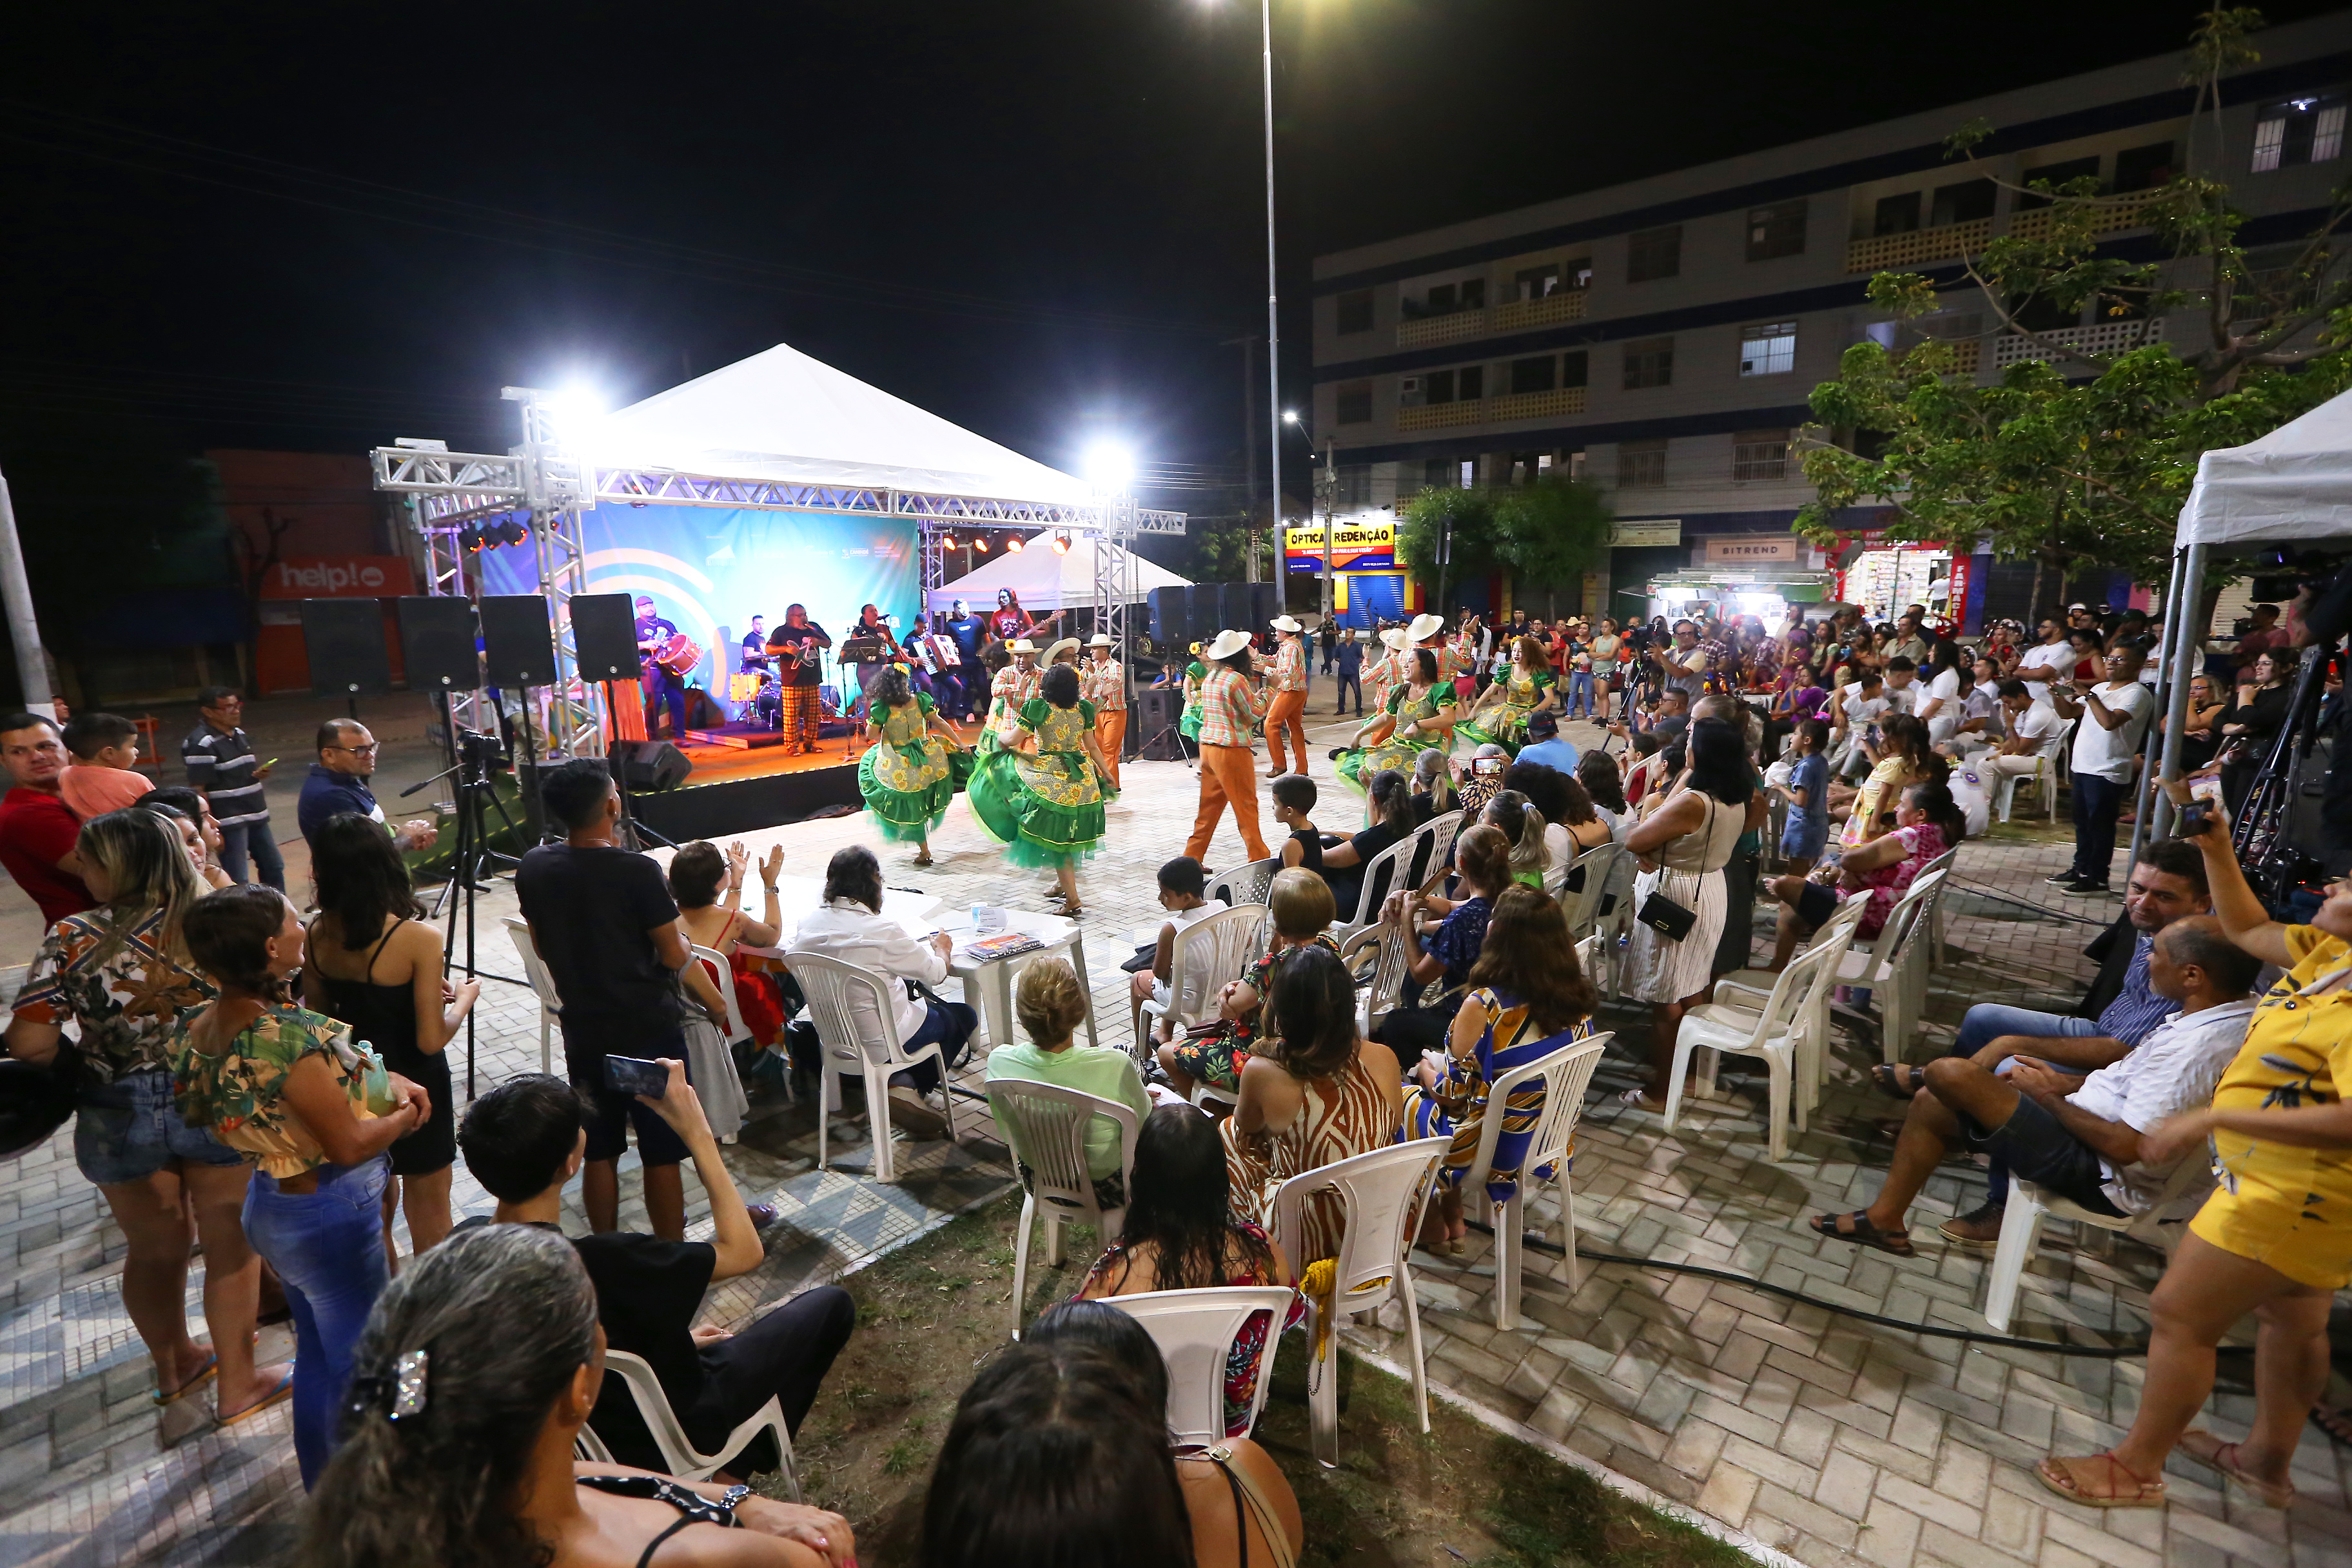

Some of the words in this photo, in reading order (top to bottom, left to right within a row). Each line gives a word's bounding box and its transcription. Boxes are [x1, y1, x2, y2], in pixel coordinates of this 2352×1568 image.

[1291, 532, 1324, 544] ÓPTICA
[1334, 529, 1389, 544] REDENÇÃO
[1723, 546, 1778, 554] BITREND
[279, 562, 358, 593] help!
